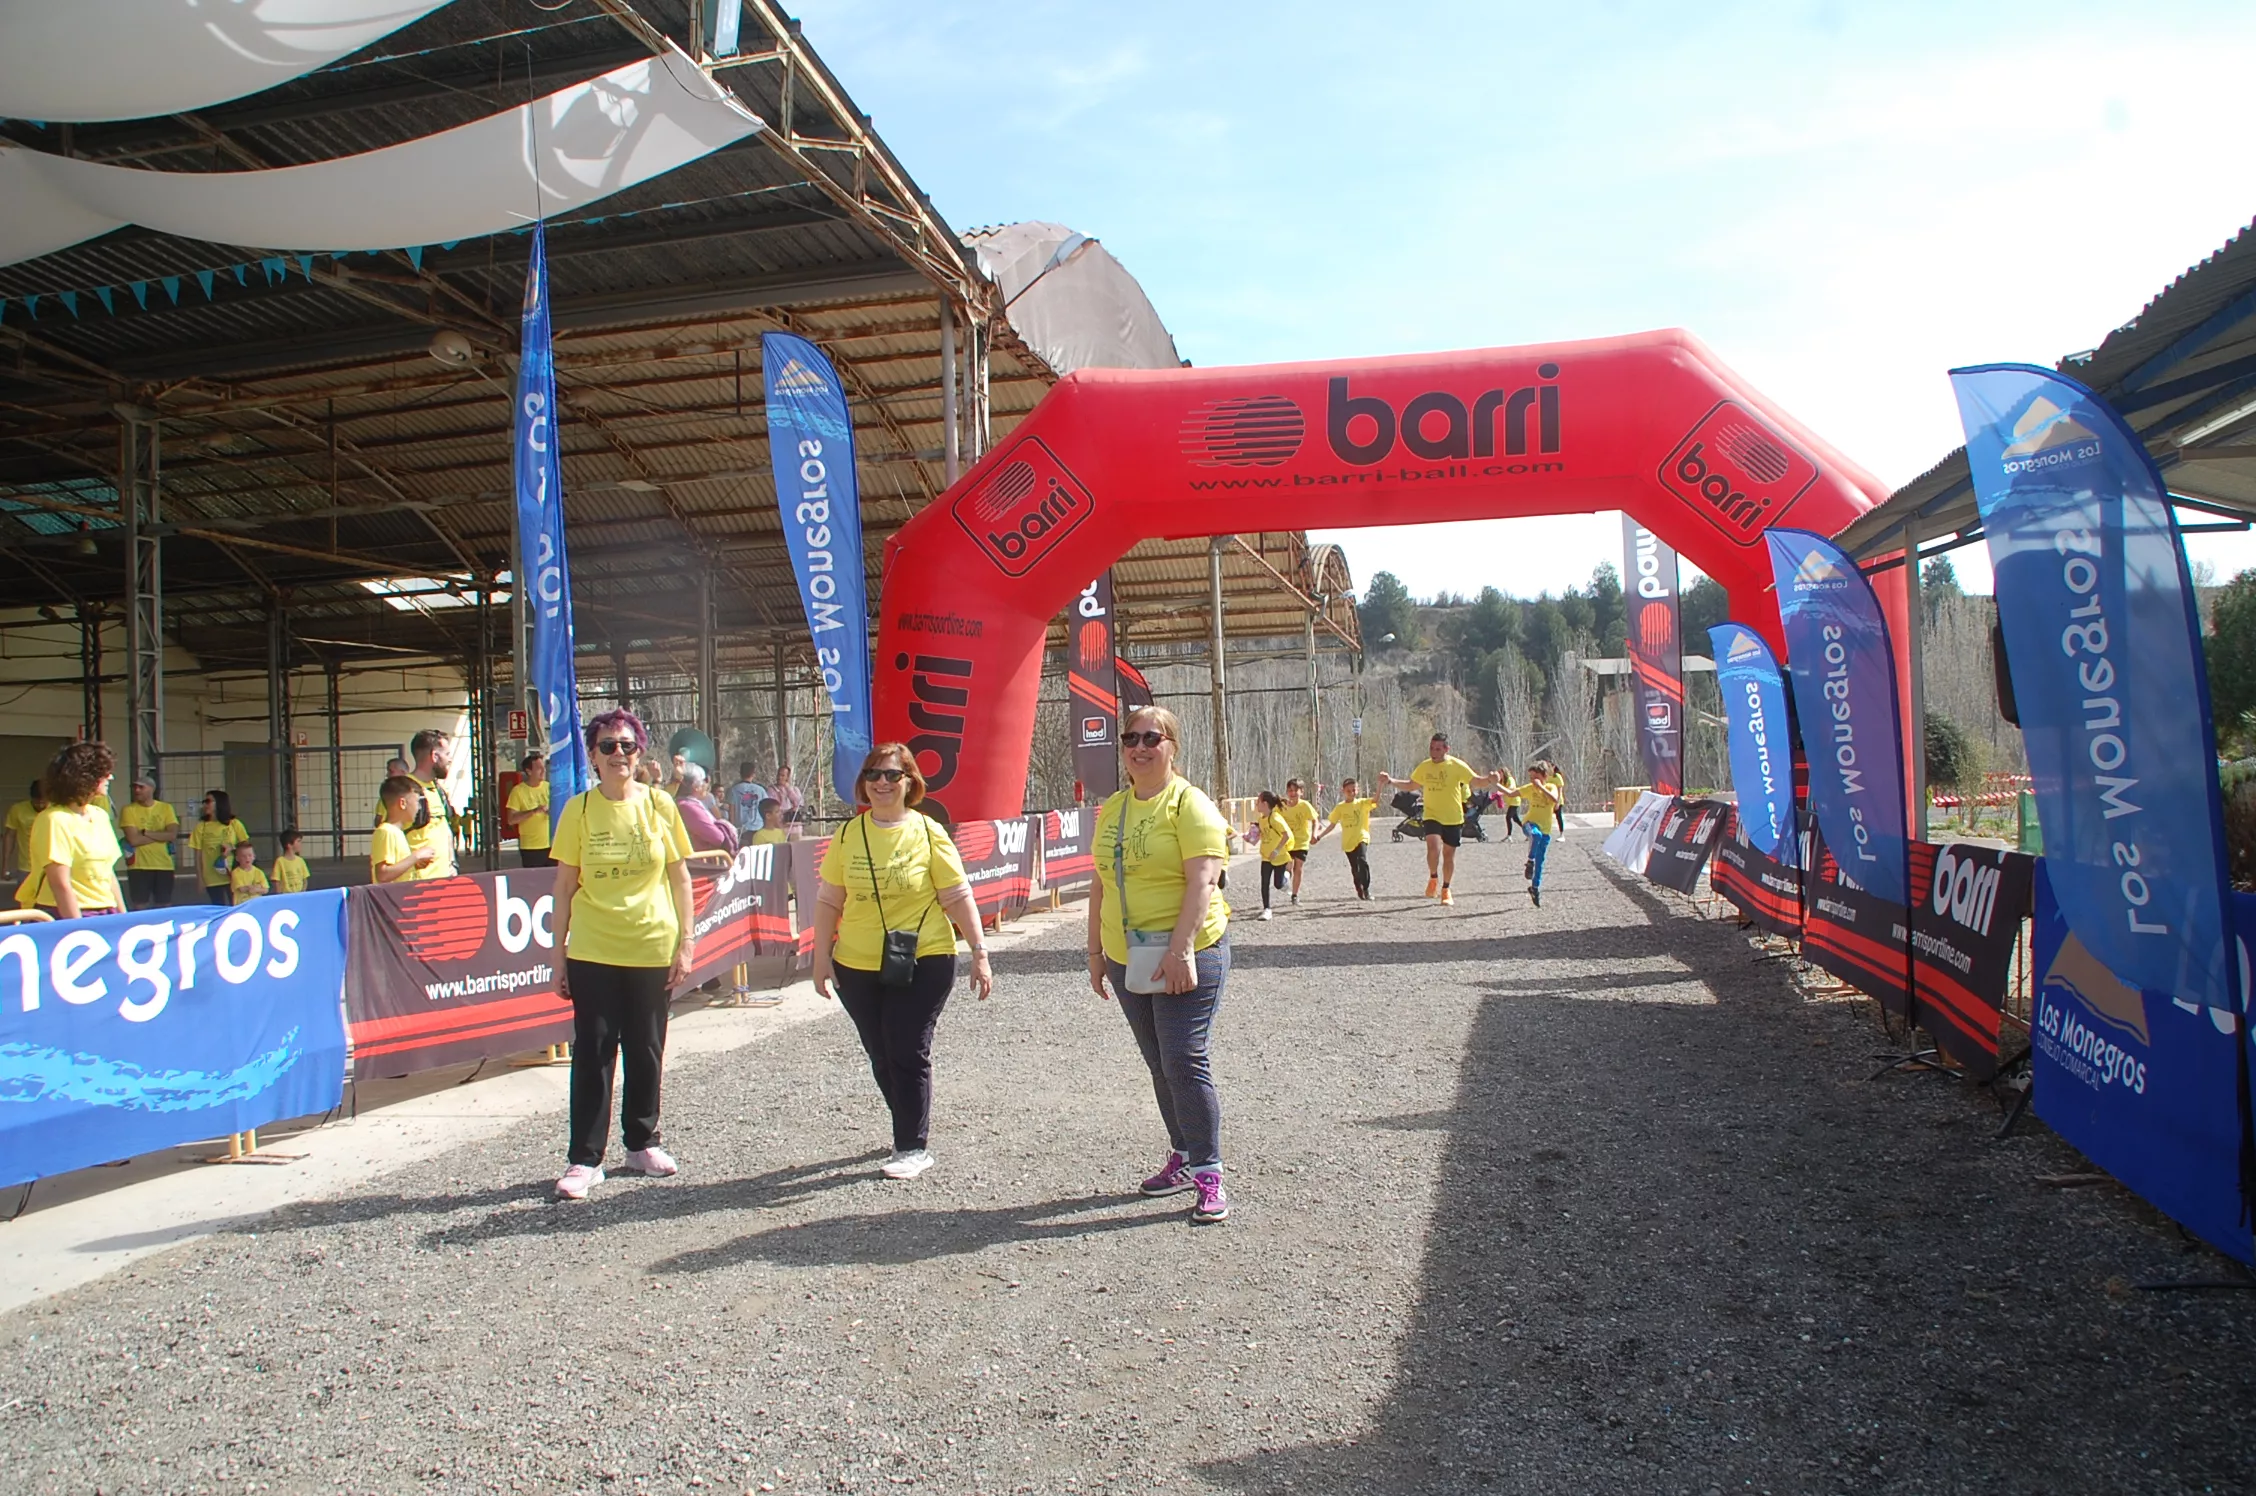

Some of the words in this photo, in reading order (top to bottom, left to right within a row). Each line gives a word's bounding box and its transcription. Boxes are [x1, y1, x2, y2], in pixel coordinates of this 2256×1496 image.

[1326, 362, 1561, 467] barri
[986, 477, 1078, 560] barri
[1188, 461, 1564, 491] www.barri-ball.com
[1676, 441, 1772, 531] barri
[895, 652, 974, 823] arri
[1933, 842, 2007, 938] barri
[1891, 922, 1972, 974] www.arrisportline.com
[2036, 1030, 2060, 1062] CONSEJO
[2060, 1049, 2101, 1091] COMARCAL
[2037, 991, 2059, 1037] Los
[2060, 1008, 2147, 1095] Monegros
